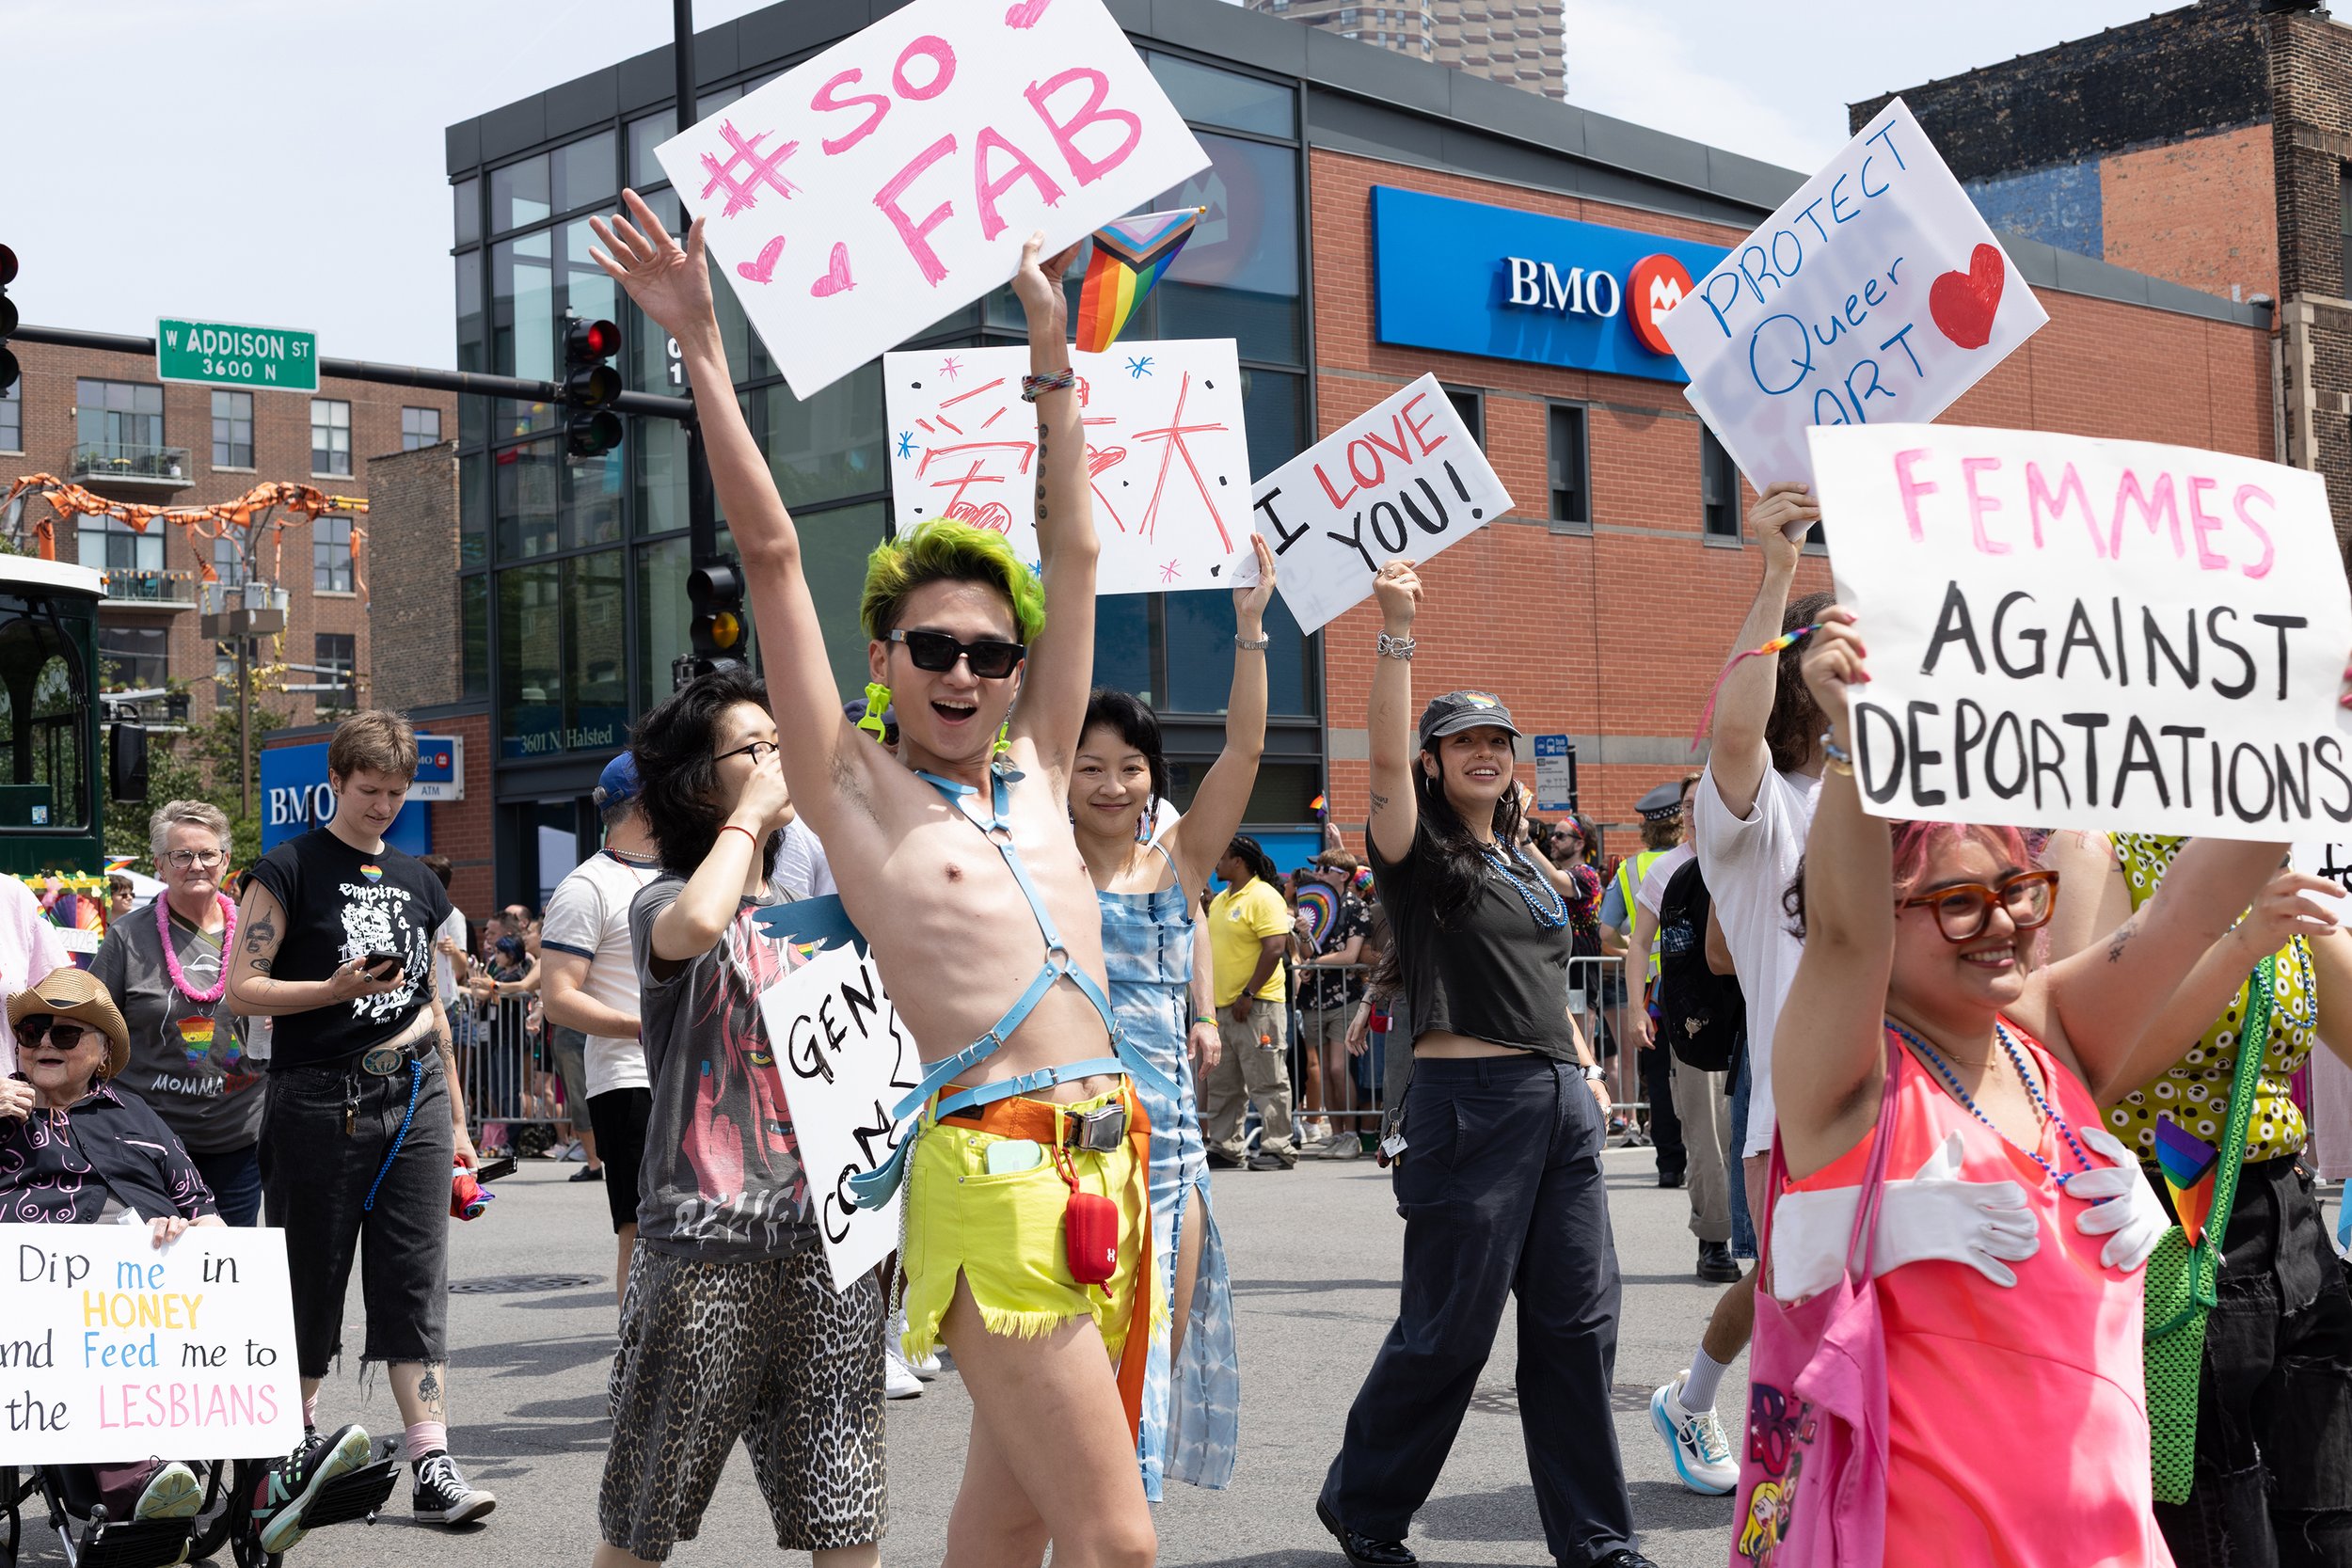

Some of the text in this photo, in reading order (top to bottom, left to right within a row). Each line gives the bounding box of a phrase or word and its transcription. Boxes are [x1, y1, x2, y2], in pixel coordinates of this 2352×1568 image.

[871, 67, 1142, 289] FAB
[1700, 119, 1906, 339] PROTECT
[1507, 255, 1621, 318] BMO
[166, 328, 310, 360] W ADDISON ST
[1749, 257, 1904, 395] Queer
[202, 358, 277, 381] 3600 N
[1815, 323, 1924, 425] ART
[1253, 392, 1448, 557] I LOVE
[1327, 459, 1483, 573] YOU!
[1894, 448, 2276, 579] FEMMES
[1920, 579, 2309, 700] AGAINST
[520, 734, 548, 753] 3601
[565, 723, 613, 749] Halsted
[1855, 698, 2352, 823] DEPORTATIONS
[268, 783, 336, 826] BMO
[421, 785, 440, 796] ATM
[788, 958, 881, 1085] GEN
[151, 1073, 224, 1097] MOMMA
[19, 1243, 240, 1290] Dip me in
[83, 1290, 203, 1331] HONEY
[85, 1331, 160, 1369] Feed
[181, 1342, 228, 1368] me
[245, 1338, 278, 1367] to
[5, 1383, 278, 1432] the LESBIANS
